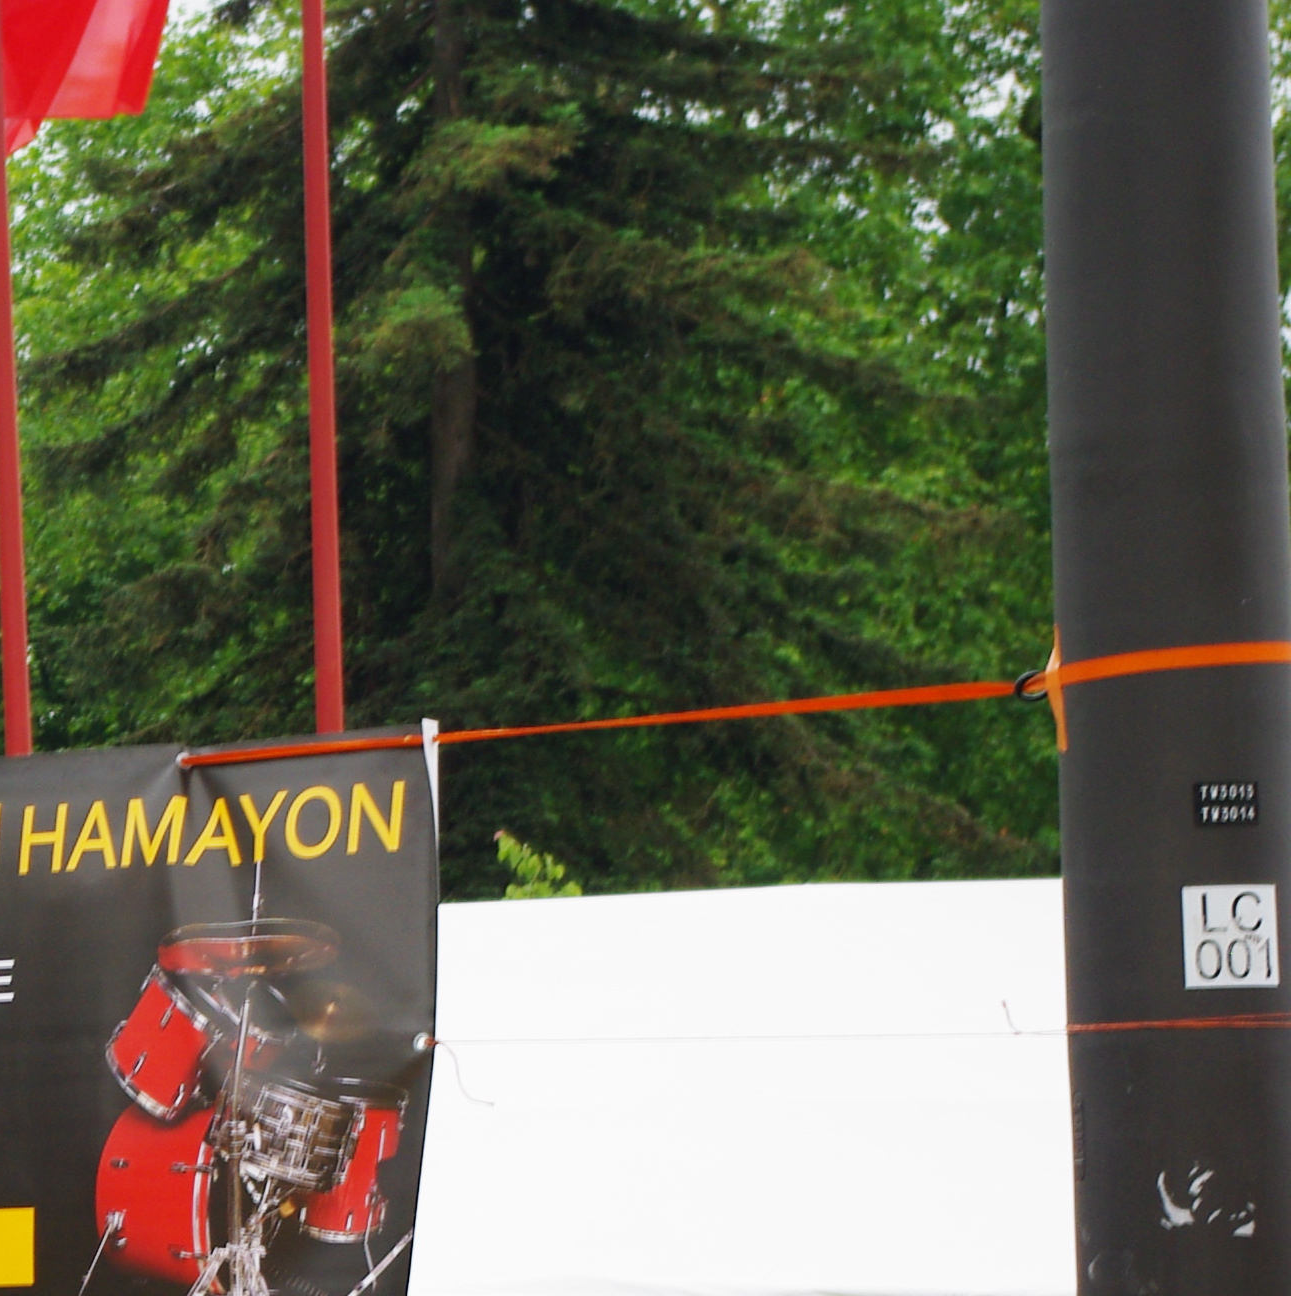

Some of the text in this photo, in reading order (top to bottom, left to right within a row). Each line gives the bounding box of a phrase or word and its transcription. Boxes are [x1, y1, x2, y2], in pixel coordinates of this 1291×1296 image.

[19, 780, 406, 876] HAMAYON
[1201, 805, 1255, 822] TW3014
[1202, 891, 1262, 932] LC
[1195, 938, 1271, 979] 001
